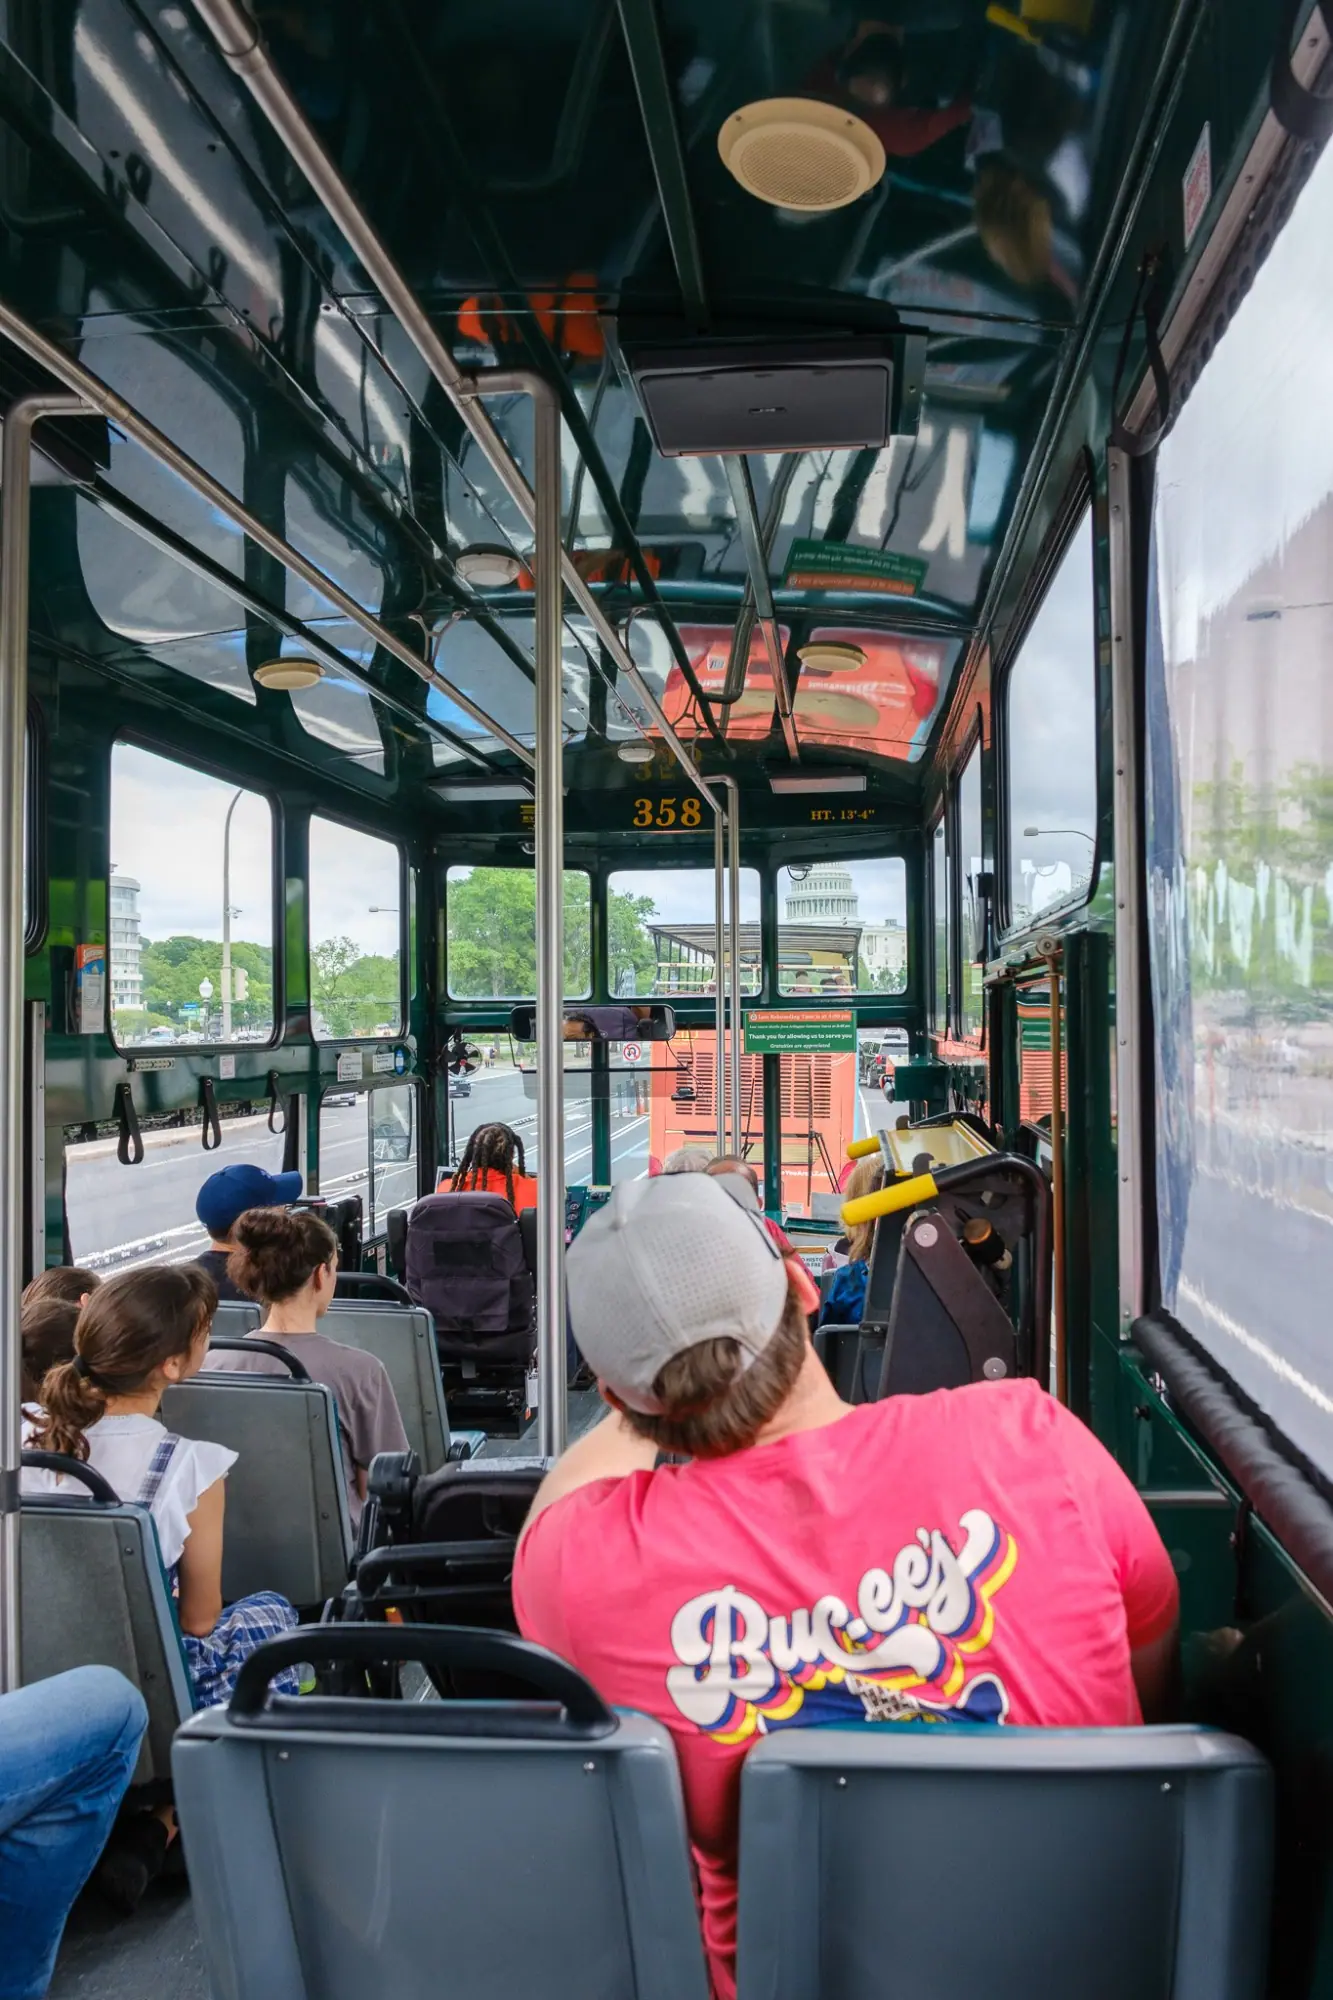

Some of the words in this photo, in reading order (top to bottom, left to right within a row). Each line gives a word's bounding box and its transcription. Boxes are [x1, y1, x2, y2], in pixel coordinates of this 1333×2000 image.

[633, 798, 701, 827] 358
[811, 810, 836, 820] HT.
[786, 1033, 810, 1041] allowing
[666, 1508, 1006, 1728] Buc-ee's
